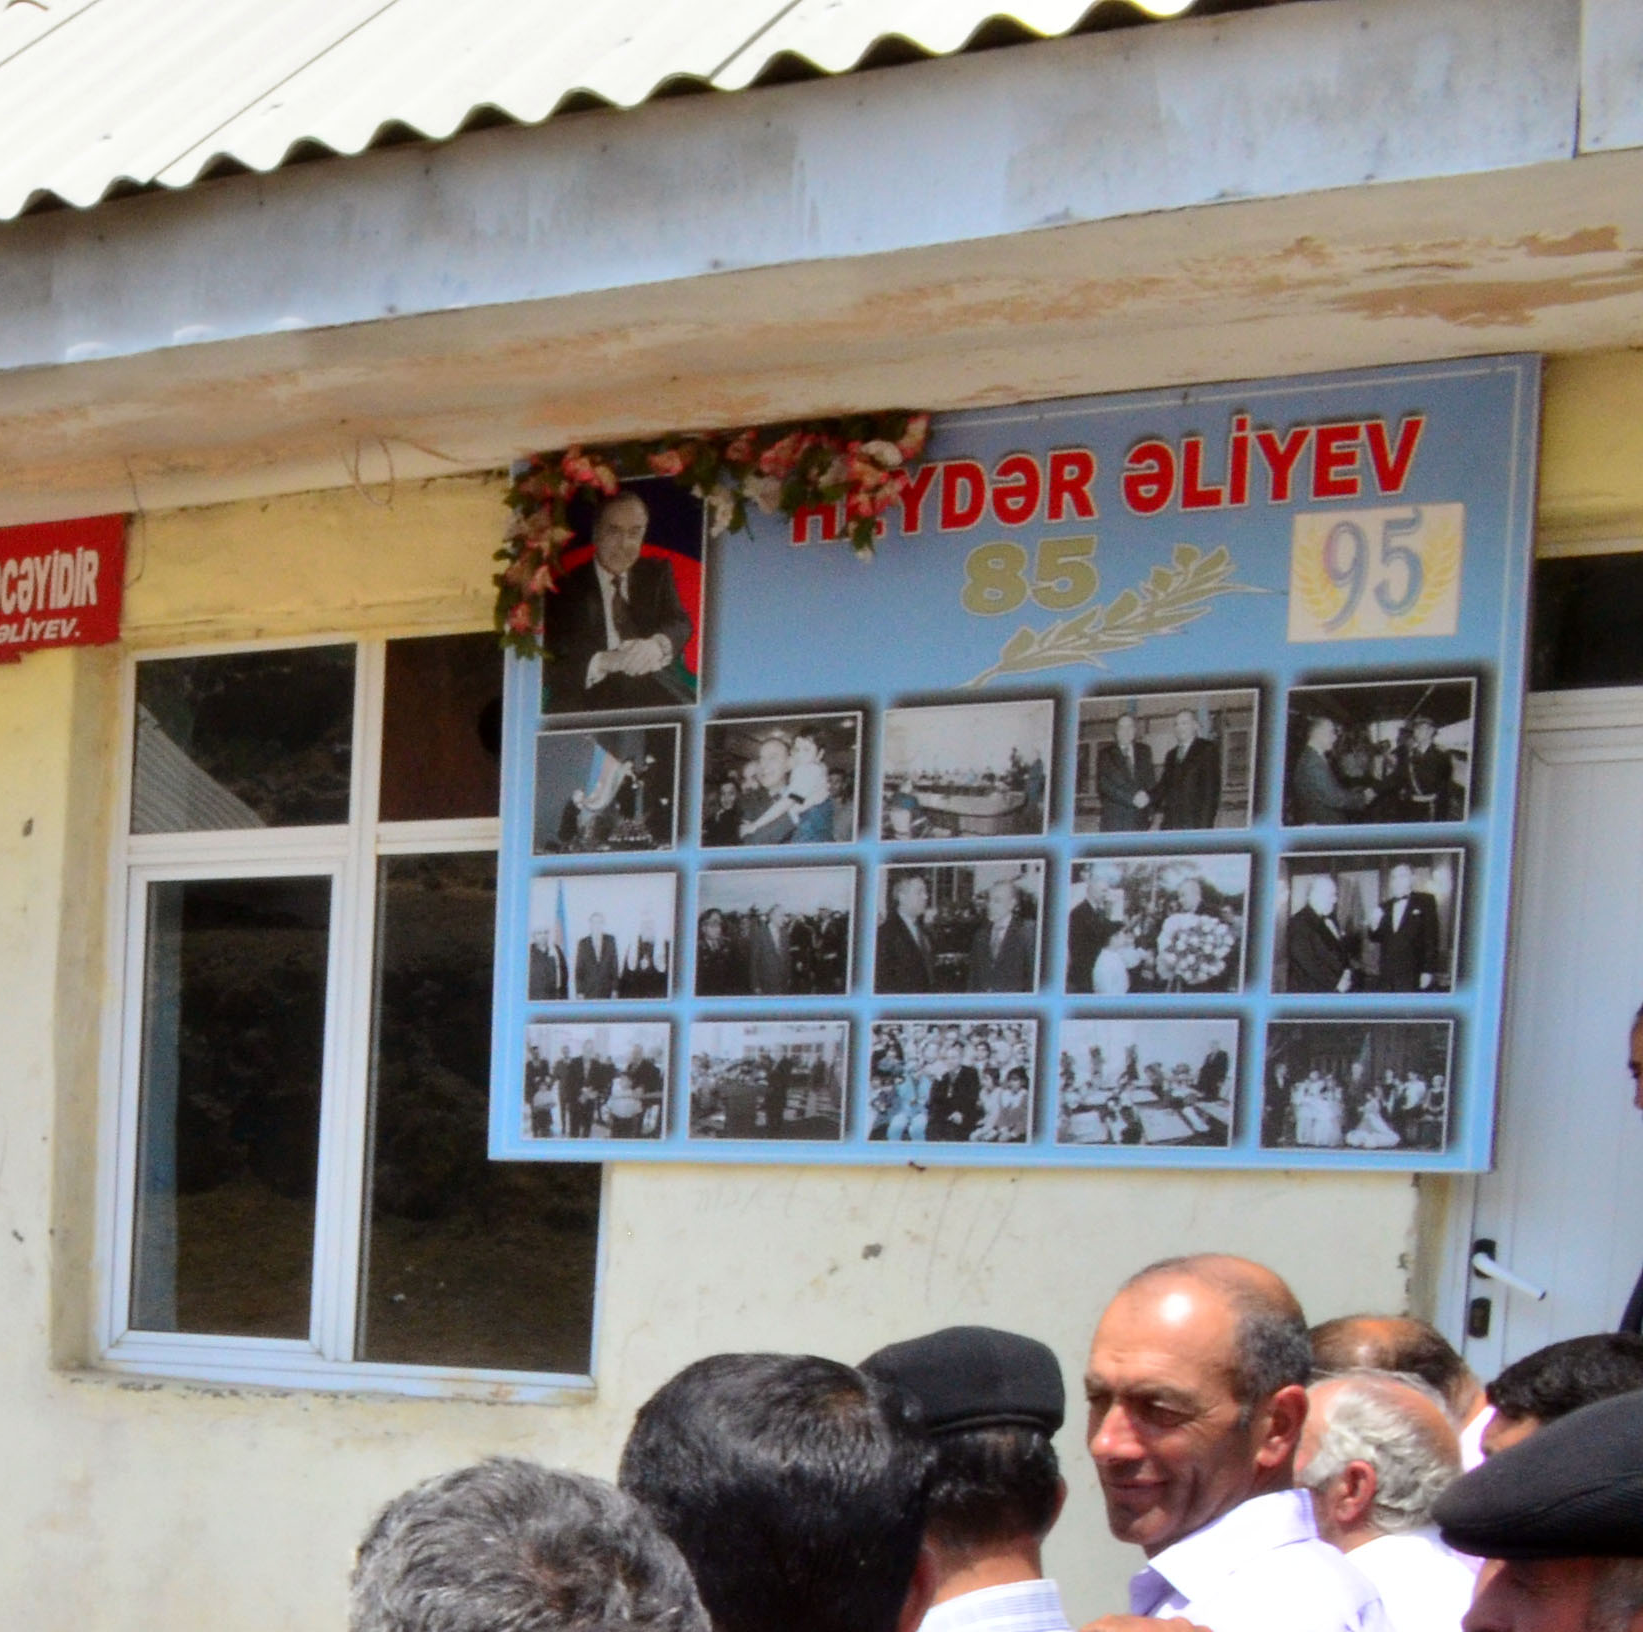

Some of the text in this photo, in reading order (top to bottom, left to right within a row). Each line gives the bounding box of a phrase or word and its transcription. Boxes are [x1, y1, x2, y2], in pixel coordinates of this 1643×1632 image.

[792, 413, 1427, 546] HYDƏR ƏLİYEV
[961, 536, 1099, 616] 85
[1322, 506, 1425, 636] 95
